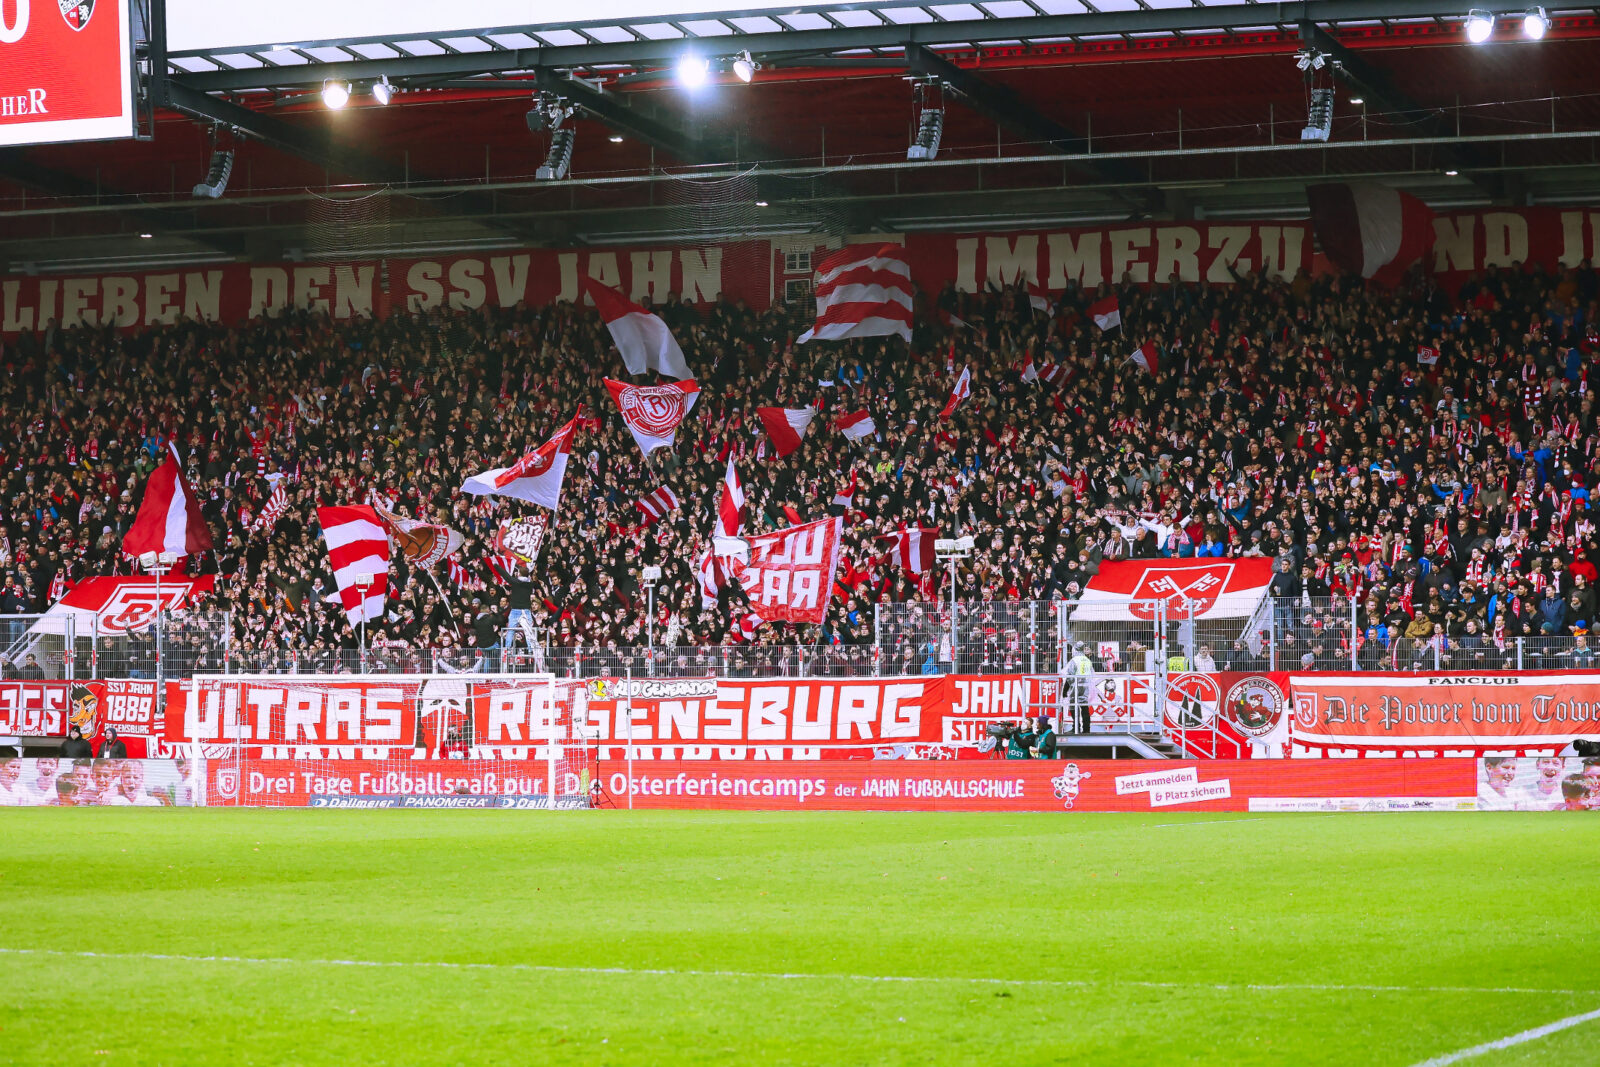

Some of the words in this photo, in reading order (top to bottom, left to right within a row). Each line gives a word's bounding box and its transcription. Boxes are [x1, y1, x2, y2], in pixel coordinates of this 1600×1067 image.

[2, 269, 223, 332] LIEBEN
[249, 265, 375, 321] DEN
[406, 254, 531, 314] SSV
[556, 247, 722, 306] JAHN
[955, 226, 1305, 294] IMMERZU
[1432, 212, 1529, 272] ND
[107, 681, 126, 693] SSV
[128, 682, 154, 695] JAHN
[642, 680, 718, 698] GENERATION
[1428, 677, 1520, 686] FANCLUB
[951, 680, 1032, 714] JAHN
[106, 695, 153, 723] 1889
[184, 687, 403, 740] ULTRAS
[487, 683, 926, 741] REGENSBURG
[1323, 695, 1370, 724] Die
[1378, 695, 1464, 730] Power
[1471, 697, 1522, 724] vom
[1531, 694, 1600, 724] Towe
[104, 723, 150, 735] REGENSBURG
[250, 771, 295, 795] Drei
[302, 771, 352, 798] Tage
[360, 770, 499, 797] Fußballspaß
[504, 778, 544, 797] pur
[565, 772, 604, 795] De
[610, 770, 827, 803] Osterferiencamps
[834, 783, 858, 797] der
[860, 778, 901, 798] JAHN
[905, 778, 1026, 798] FUßBALLSCHULE
[1120, 779, 1144, 791] Jetzt
[1145, 773, 1193, 787] anmelden
[404, 797, 485, 808] PANOMERA
[1155, 792, 1164, 802] &
[1165, 789, 1188, 801] Platz
[1190, 785, 1226, 798] sichern
